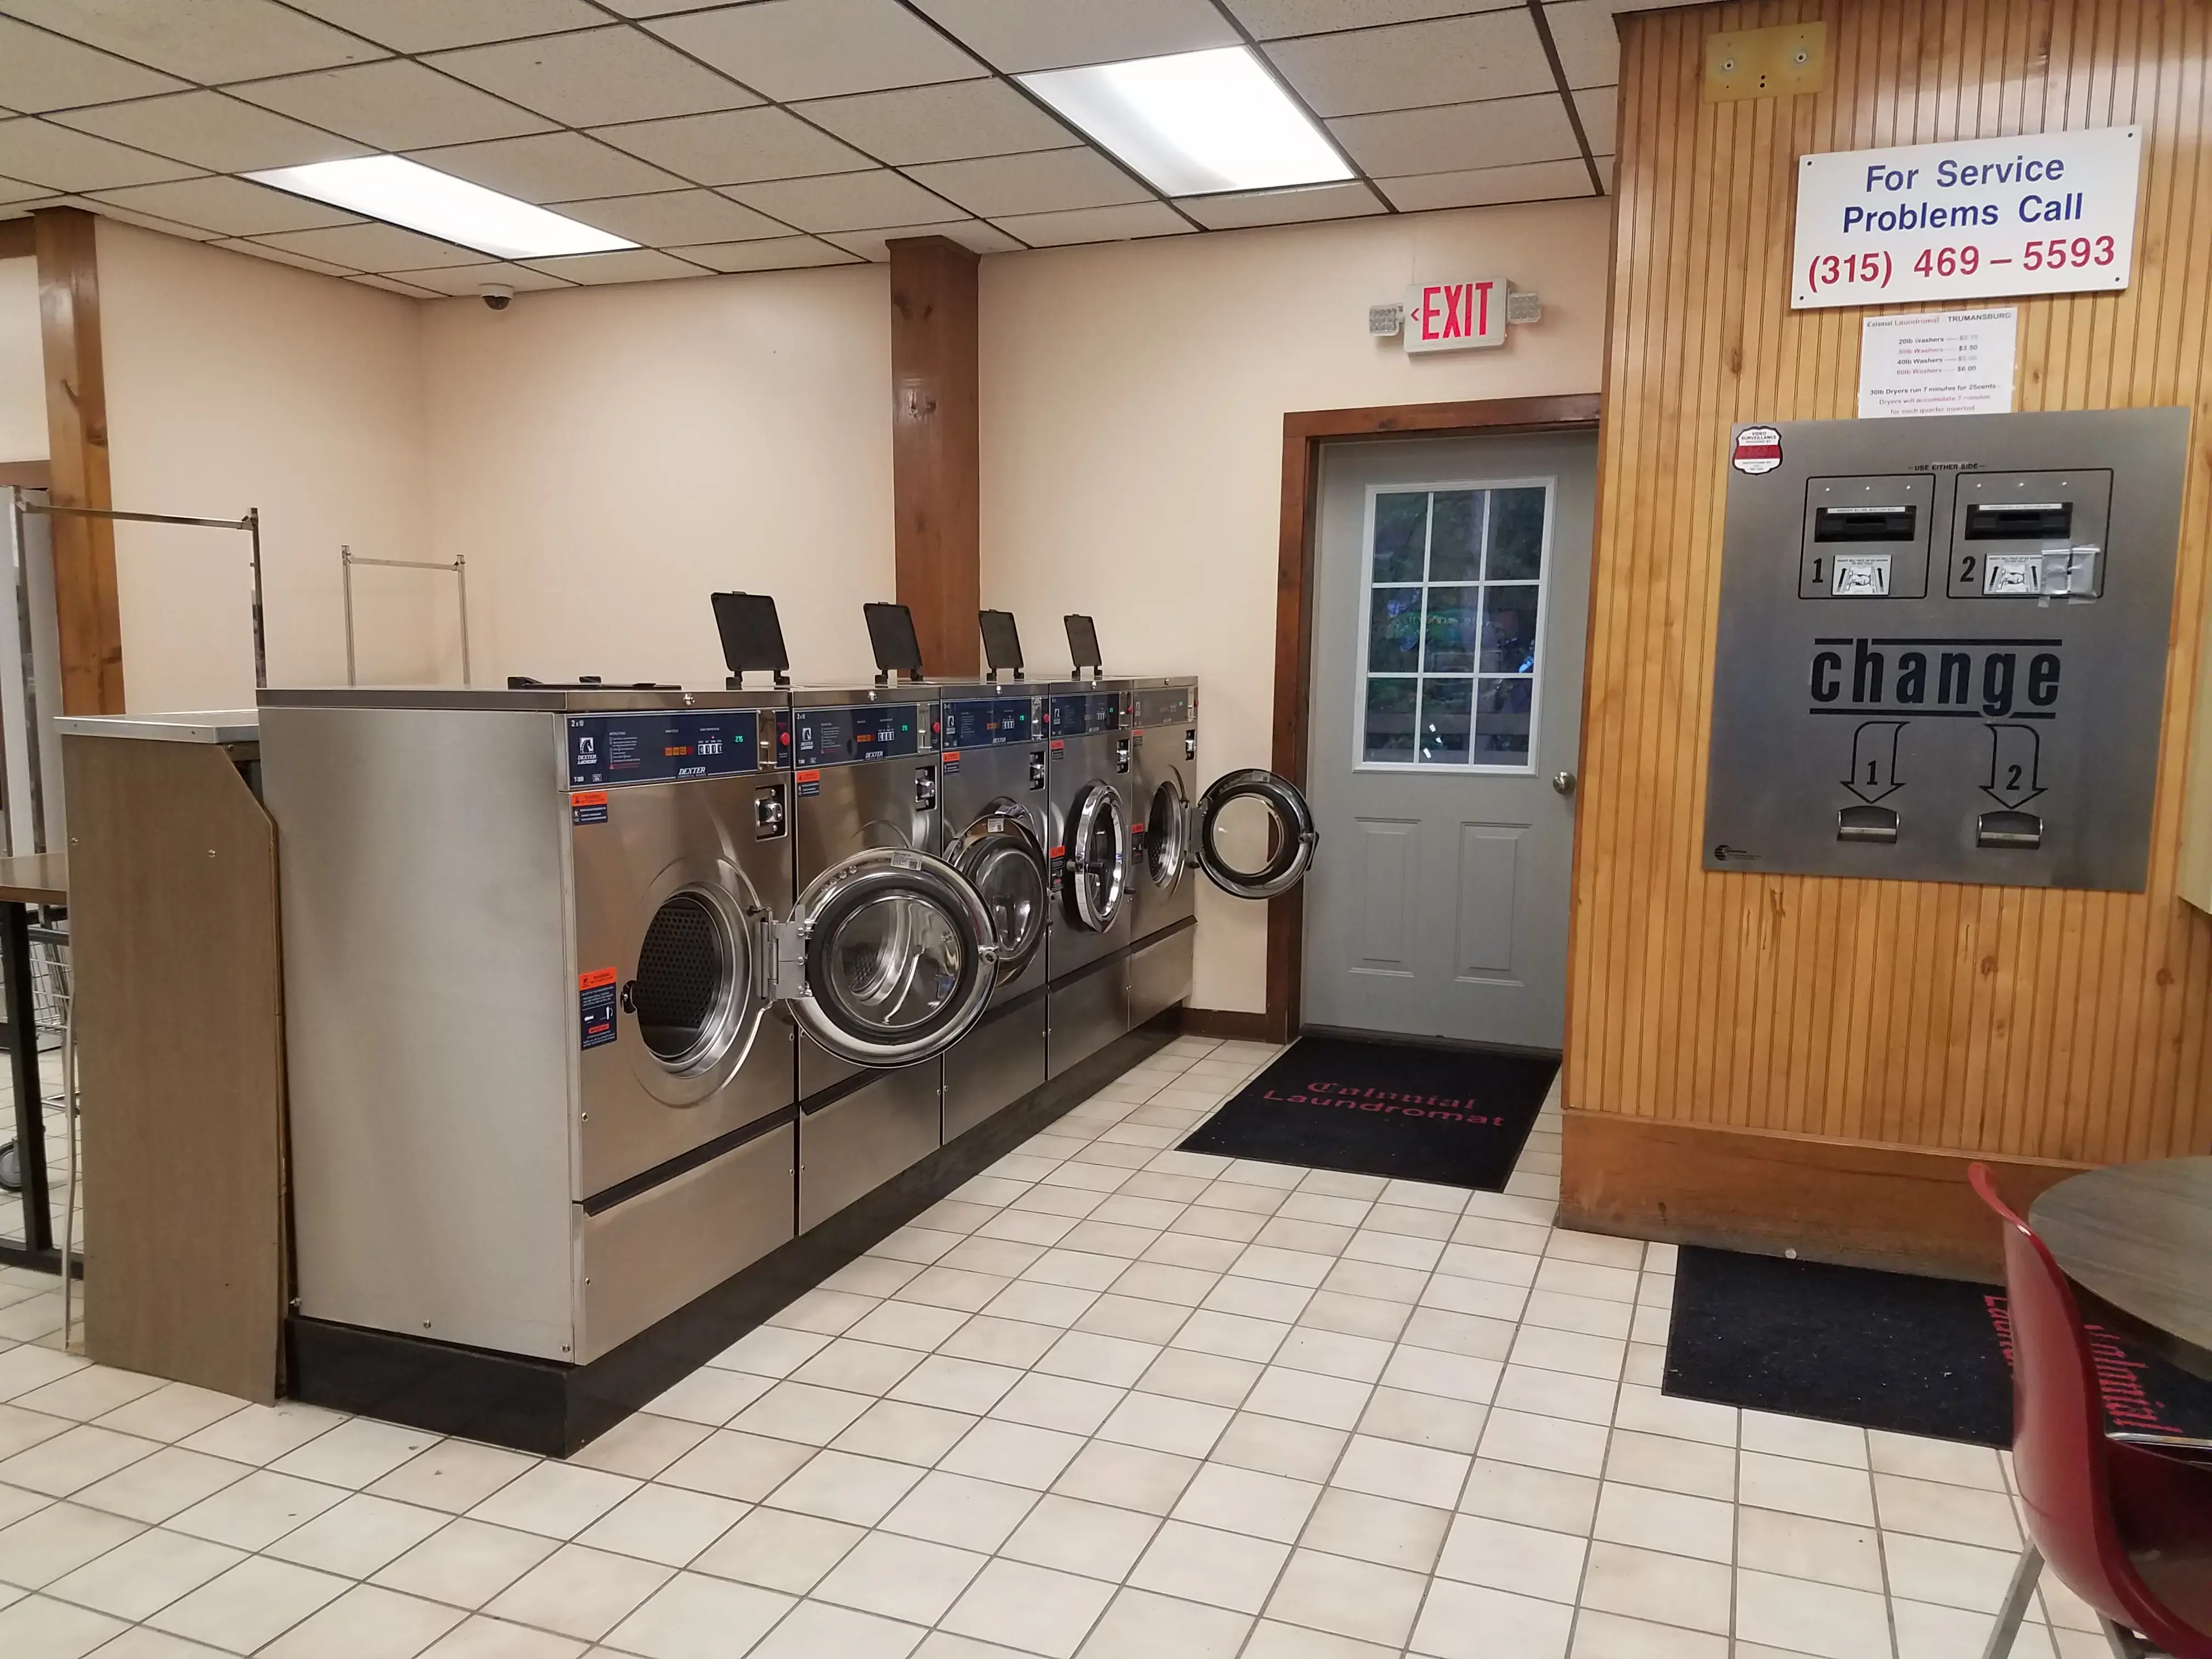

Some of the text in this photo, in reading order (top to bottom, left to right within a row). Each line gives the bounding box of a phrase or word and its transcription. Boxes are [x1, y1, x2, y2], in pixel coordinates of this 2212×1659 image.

[1865, 155, 2065, 193] For Service
[1843, 192, 2083, 234] Problems Call
[1809, 250, 1893, 294] (315)
[1914, 245, 1979, 278] 469
[2023, 235, 2115, 271] 5593
[1422, 281, 1493, 340] EXIT
[1948, 312, 2011, 323] TRUMANSBURG
[1879, 398, 1902, 406] Dryers
[1886, 387, 1909, 397] Dryers
[1920, 407, 1944, 415] quarter
[1812, 557, 1824, 583] 1
[1960, 556, 1976, 583] 2
[1810, 638, 2062, 718] change
[865, 751, 884, 759] DEXTER
[678, 766, 706, 776] DEXTER
[1866, 760, 1878, 786] 1
[2006, 764, 2022, 791] 2
[1263, 1090, 1506, 1127] Laundromat
[1307, 1081, 1476, 1111] Colonial
